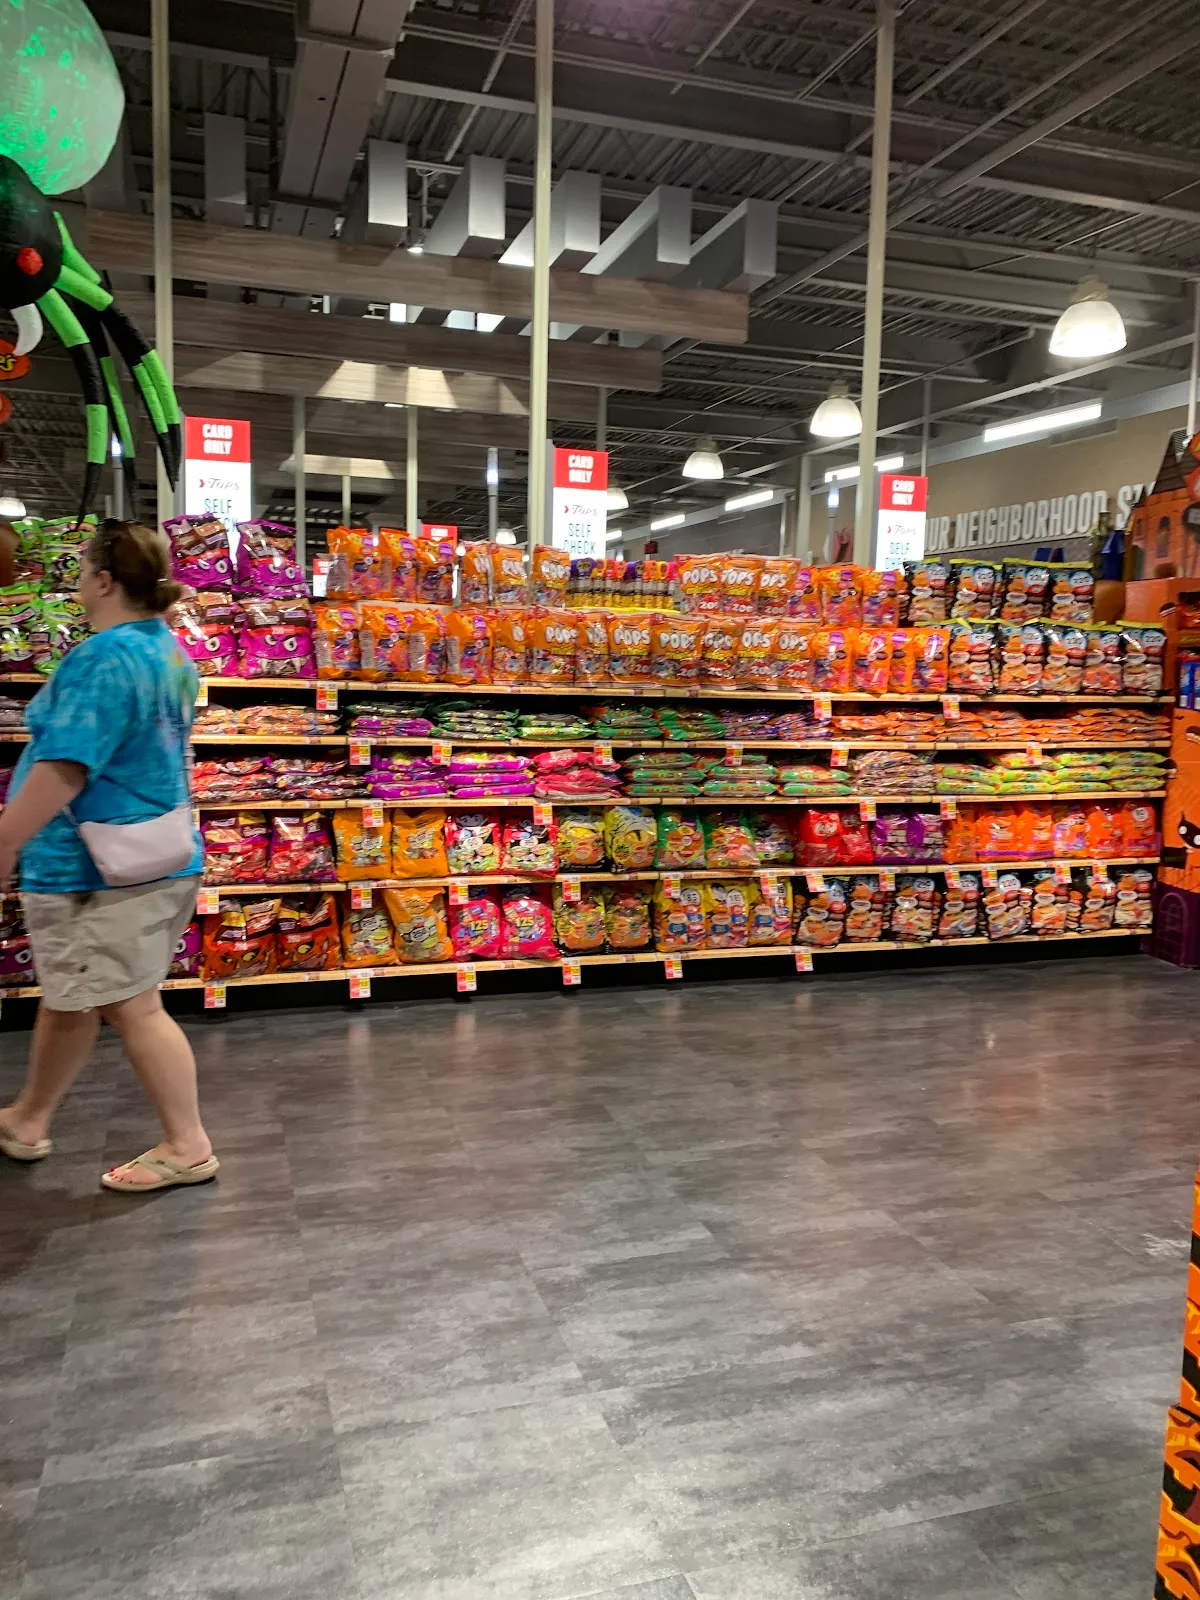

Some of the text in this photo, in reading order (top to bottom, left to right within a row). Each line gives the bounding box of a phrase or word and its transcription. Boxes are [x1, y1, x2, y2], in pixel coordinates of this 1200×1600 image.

[202, 423, 233, 440] CARD
[203, 439, 232, 455] ONLY
[568, 454, 594, 469] CARD
[568, 469, 593, 484] ONLY
[204, 498, 232, 514] SELF
[955, 489, 1108, 549] NEIGHBORHOOD
[568, 523, 591, 538] SELF
[563, 540, 596, 555] CHECK
[682, 567, 718, 585] POPS
[760, 573, 788, 588] OPS
[613, 627, 651, 646] POPS
[742, 631, 772, 648] OPS
[779, 632, 809, 651] OPS
[470, 919, 489, 931] 125
[515, 916, 535, 927] 125
